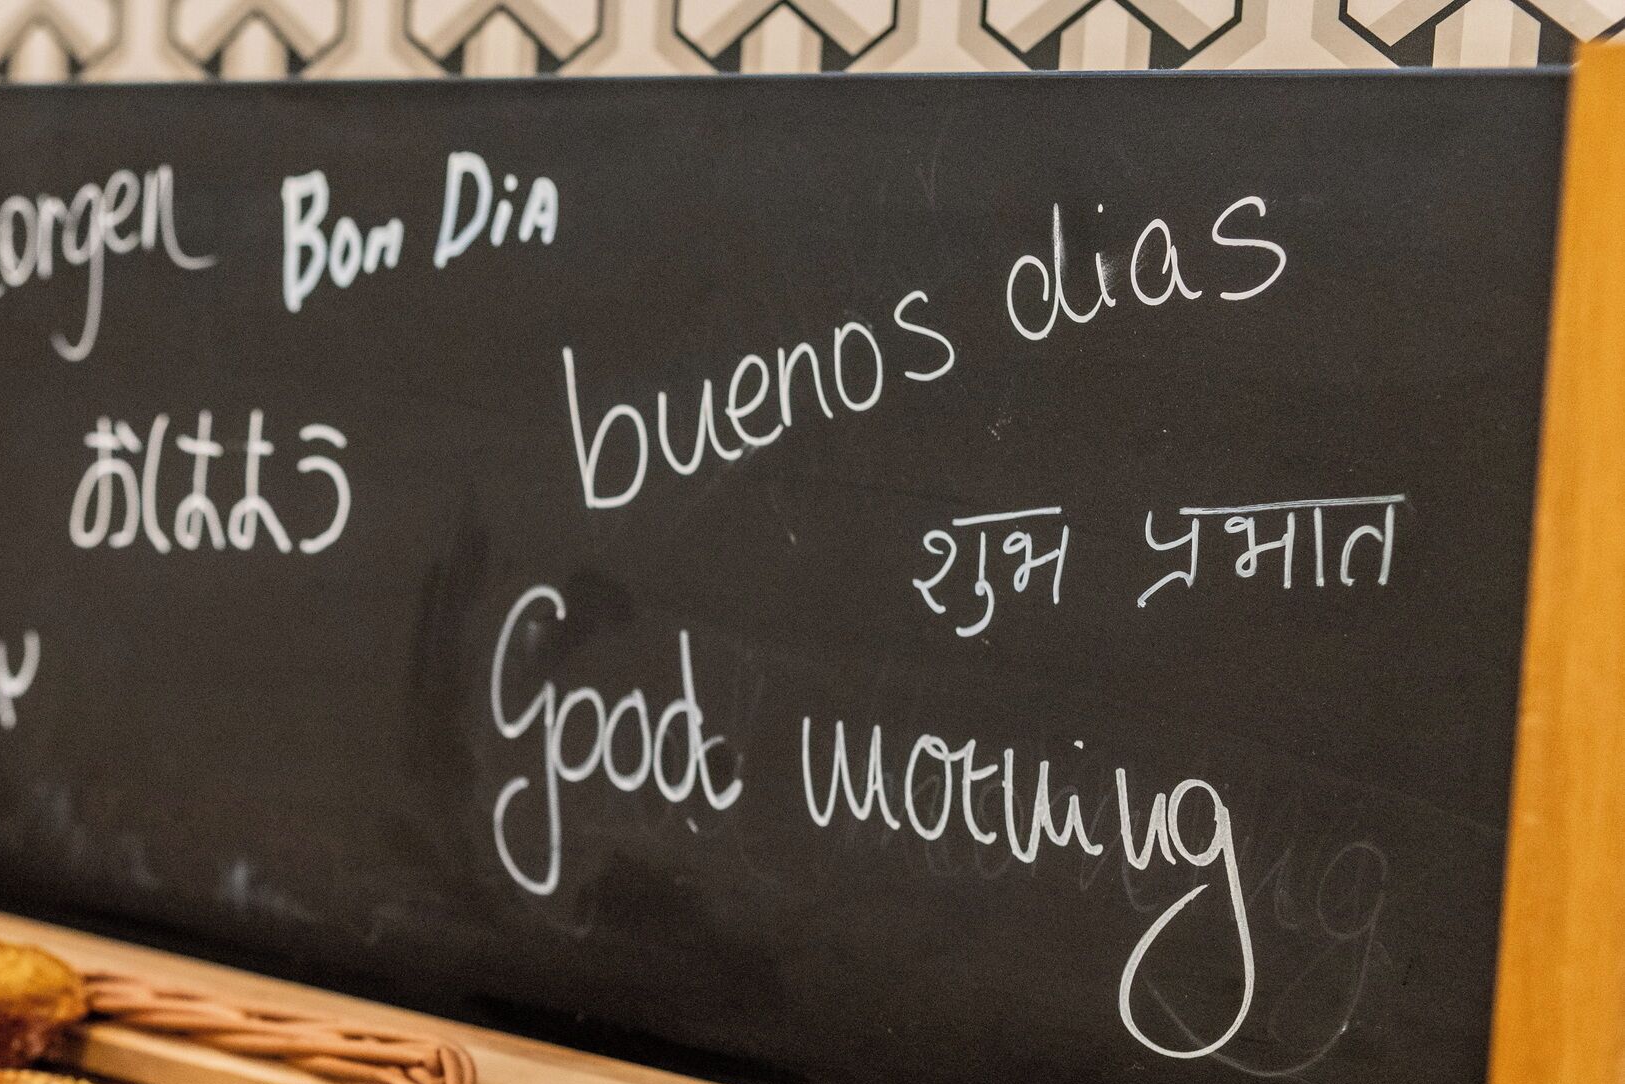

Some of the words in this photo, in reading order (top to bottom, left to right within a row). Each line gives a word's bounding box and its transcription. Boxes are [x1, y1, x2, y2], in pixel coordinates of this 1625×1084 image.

[280, 169, 405, 313] Bon
[562, 290, 957, 510] buenos
[1007, 196, 1288, 342] dias
[69, 408, 352, 555] おはよう
[912, 505, 1070, 638] शुभ
[1136, 494, 1406, 609] प्रभात
[490, 585, 744, 896] Good
[801, 717, 1257, 1060] morning
